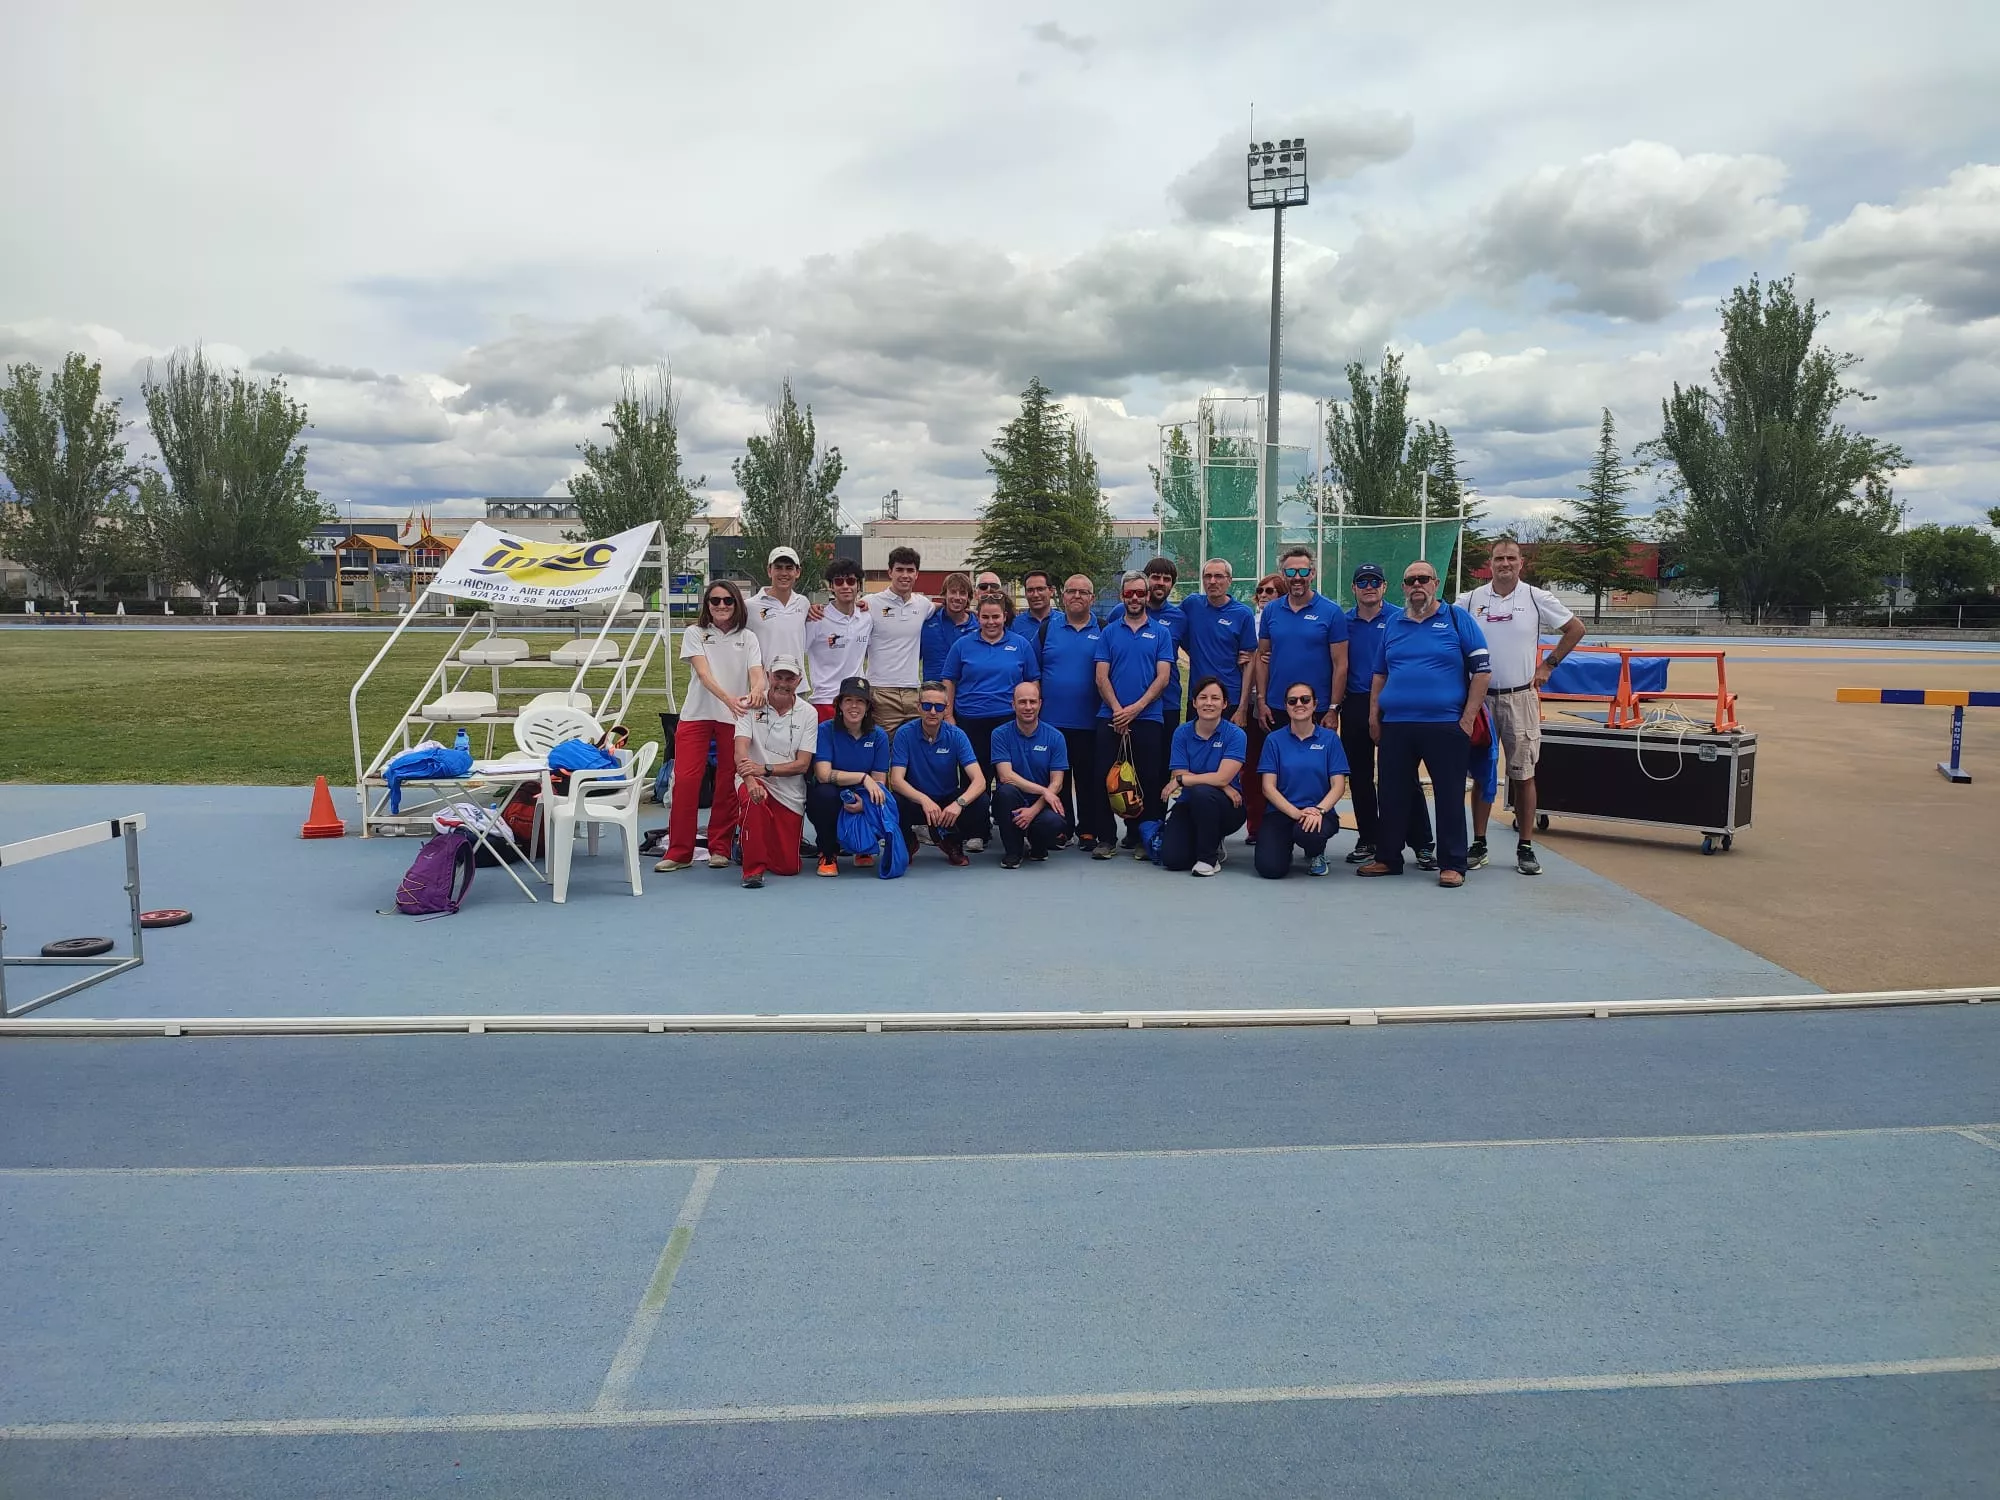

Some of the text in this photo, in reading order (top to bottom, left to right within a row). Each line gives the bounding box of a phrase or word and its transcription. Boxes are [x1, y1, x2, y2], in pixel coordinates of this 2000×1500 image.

[471, 590, 488, 598] 974
[491, 593, 505, 601] 23
[546, 596, 588, 605] HUESCA
[520, 587, 545, 596] AIRE
